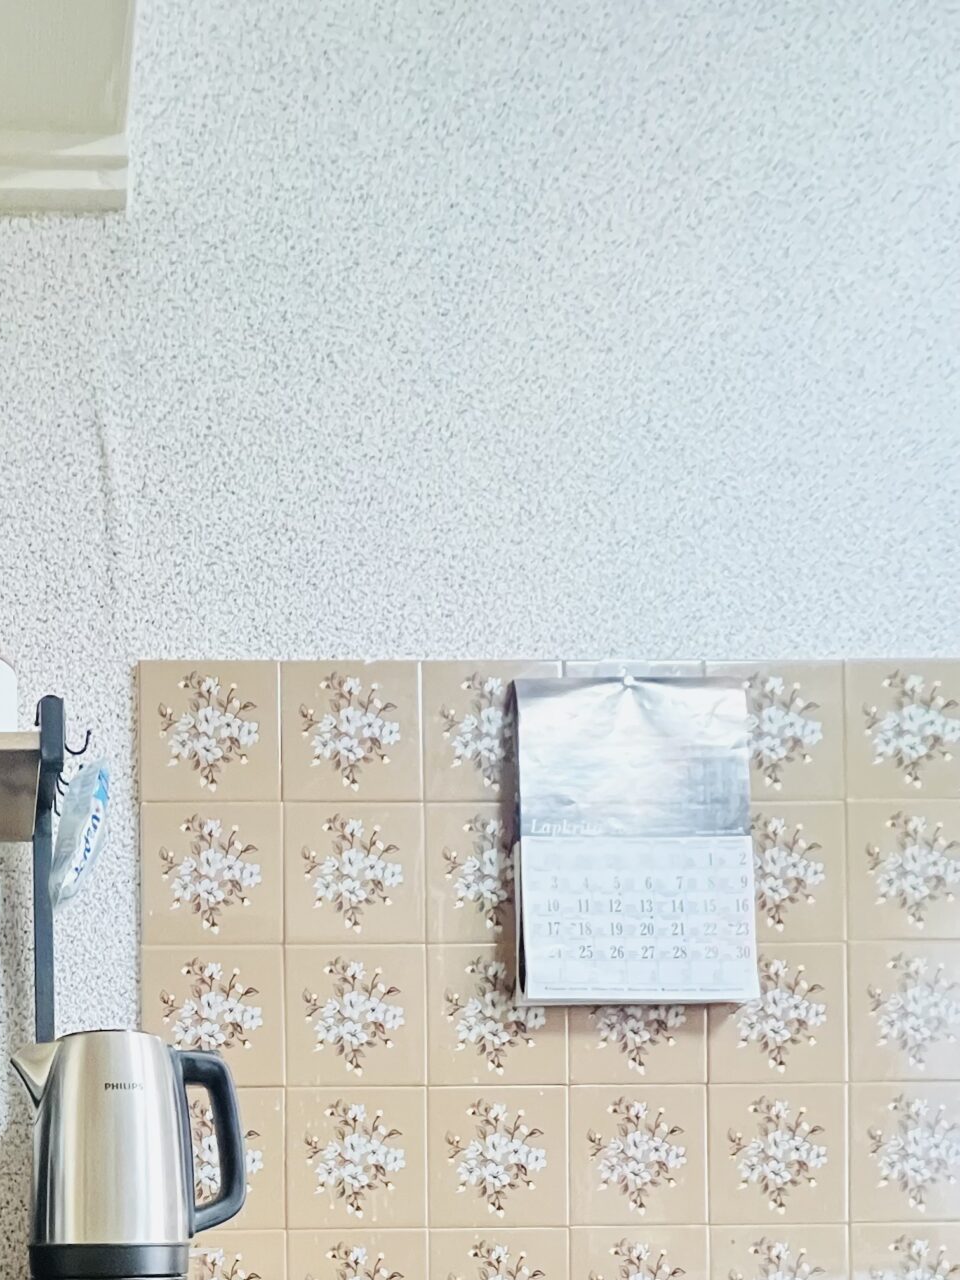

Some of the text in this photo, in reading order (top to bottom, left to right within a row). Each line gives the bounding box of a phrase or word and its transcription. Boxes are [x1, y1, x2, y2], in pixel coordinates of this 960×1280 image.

[738, 852, 747, 866] 2
[551, 876, 559, 889] 3
[613, 876, 621, 889] 5
[645, 876, 653, 890] 6
[676, 876, 683, 890] 7
[740, 875, 749, 889] 9
[547, 899, 749, 913] 10 11 12 13 14 15 16
[548, 922, 750, 937] 17 18 19 20 21 22 23
[580, 945, 593, 959] 25
[610, 945, 625, 959] 26
[641, 945, 655, 960] 27
[672, 945, 688, 960] 28
[704, 945, 720, 960] 29
[736, 945, 751, 960] 30
[104, 1082, 144, 1091] PHILIPS
